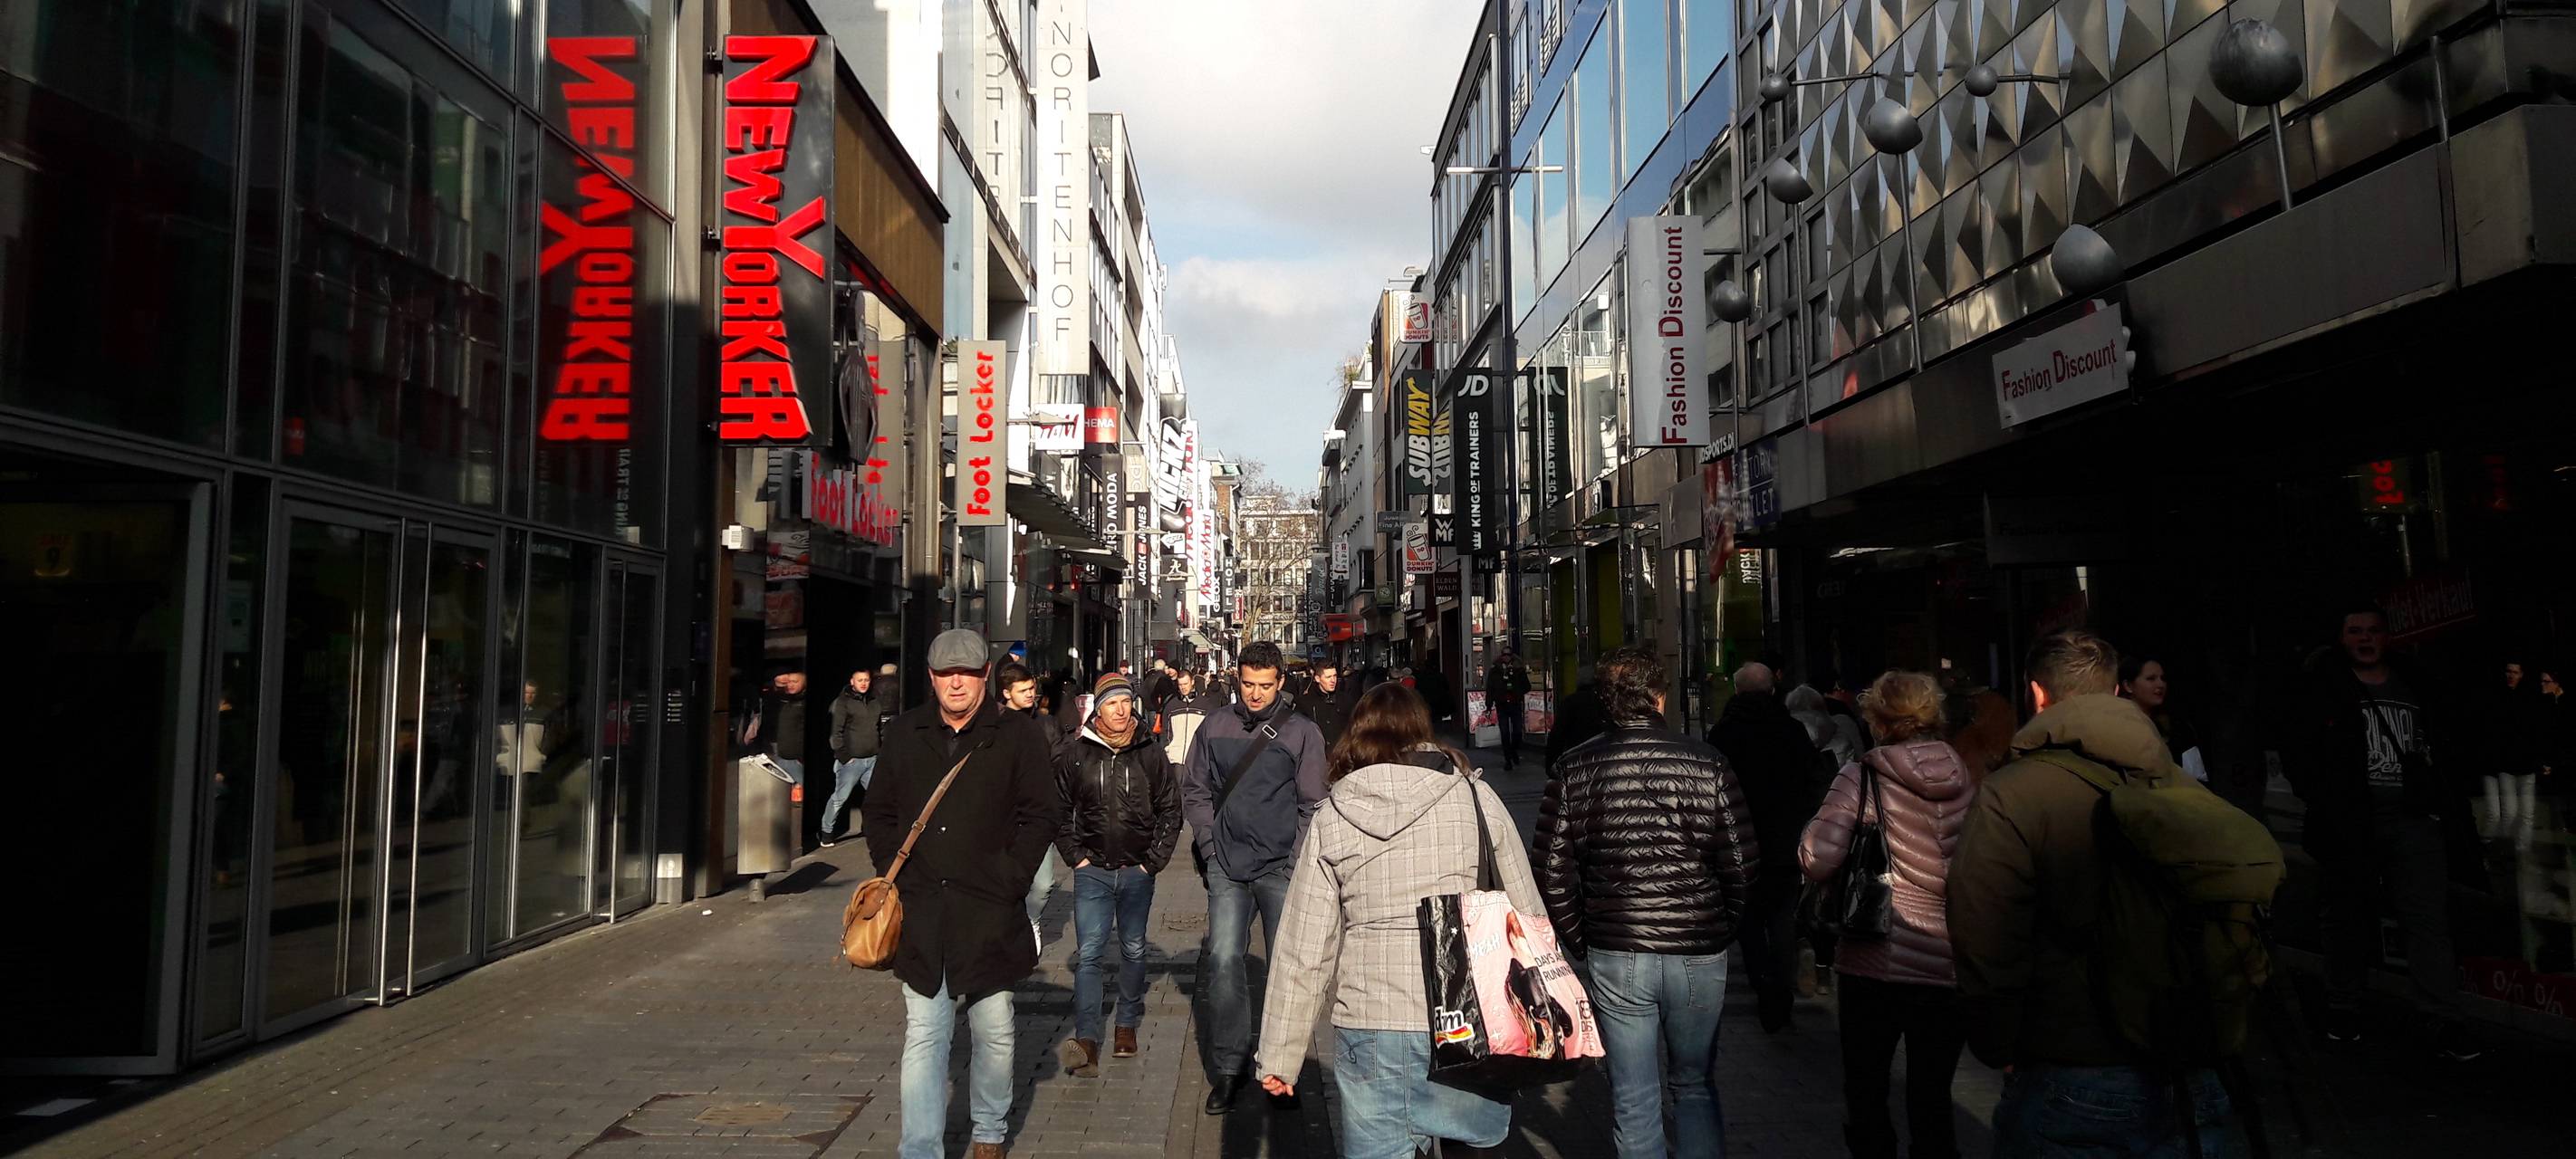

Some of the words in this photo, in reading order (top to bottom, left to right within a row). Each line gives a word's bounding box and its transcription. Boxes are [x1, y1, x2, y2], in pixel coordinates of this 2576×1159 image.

[1658, 226, 1684, 338] Discount
[1457, 374, 1490, 397] JD
[2001, 369, 2052, 402] Fashion
[2052, 339, 2117, 383] Discount
[969, 350, 995, 444] Locker
[1662, 348, 1687, 445] Fashion
[1407, 377, 1432, 487] SUBWAY
[1469, 411, 1480, 477] TRAINERS
[966, 457, 992, 517] Foot
[1106, 472, 1118, 519] MODA
[1471, 480, 1481, 493] OF
[1471, 497, 1482, 527] KING
[1138, 555, 1148, 586] JACK
[1200, 559, 1213, 601] Media
[1535, 953, 1556, 968] DAYS
[1435, 1007, 1463, 1031] dm
